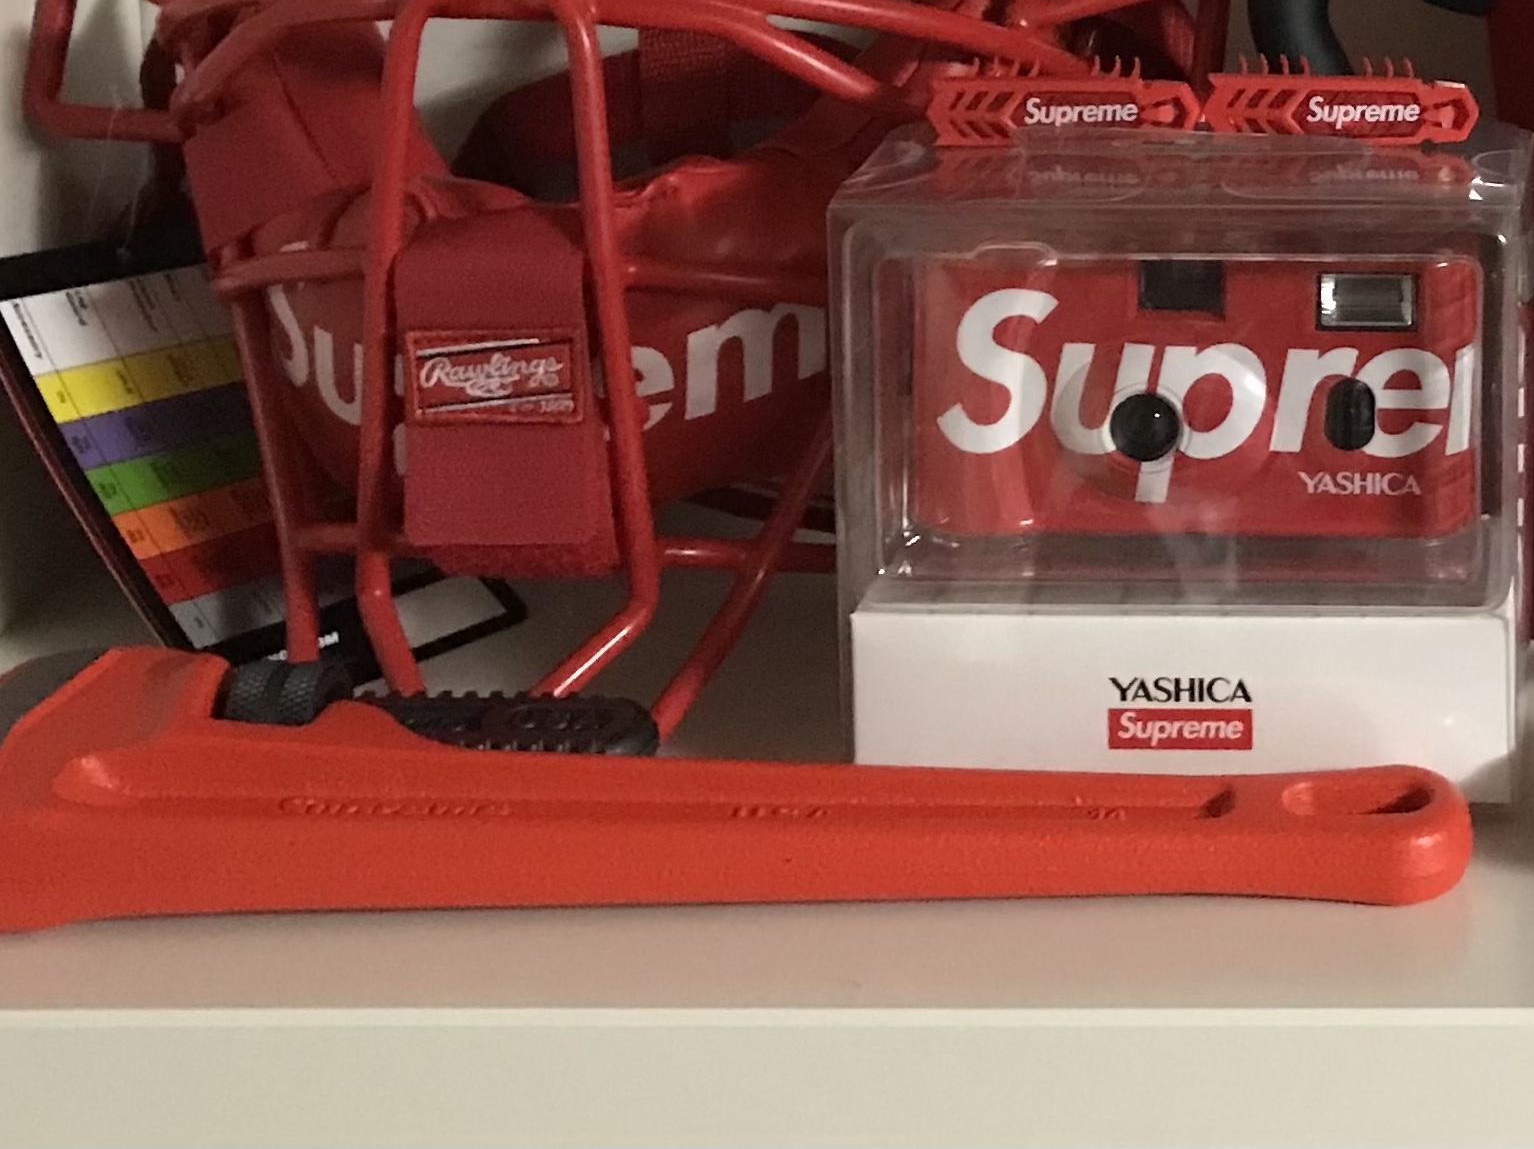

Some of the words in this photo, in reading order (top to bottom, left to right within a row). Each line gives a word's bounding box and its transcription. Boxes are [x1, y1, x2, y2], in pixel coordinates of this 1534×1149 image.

[1023, 96, 1139, 127] Supreme
[1306, 95, 1421, 126] Supreme
[419, 351, 564, 391] Rawlings
[936, 286, 1474, 504] Supre
[1298, 471, 1421, 498] YASHICA
[1109, 677, 1252, 704] YASHICA
[1117, 712, 1244, 746] Supreme
